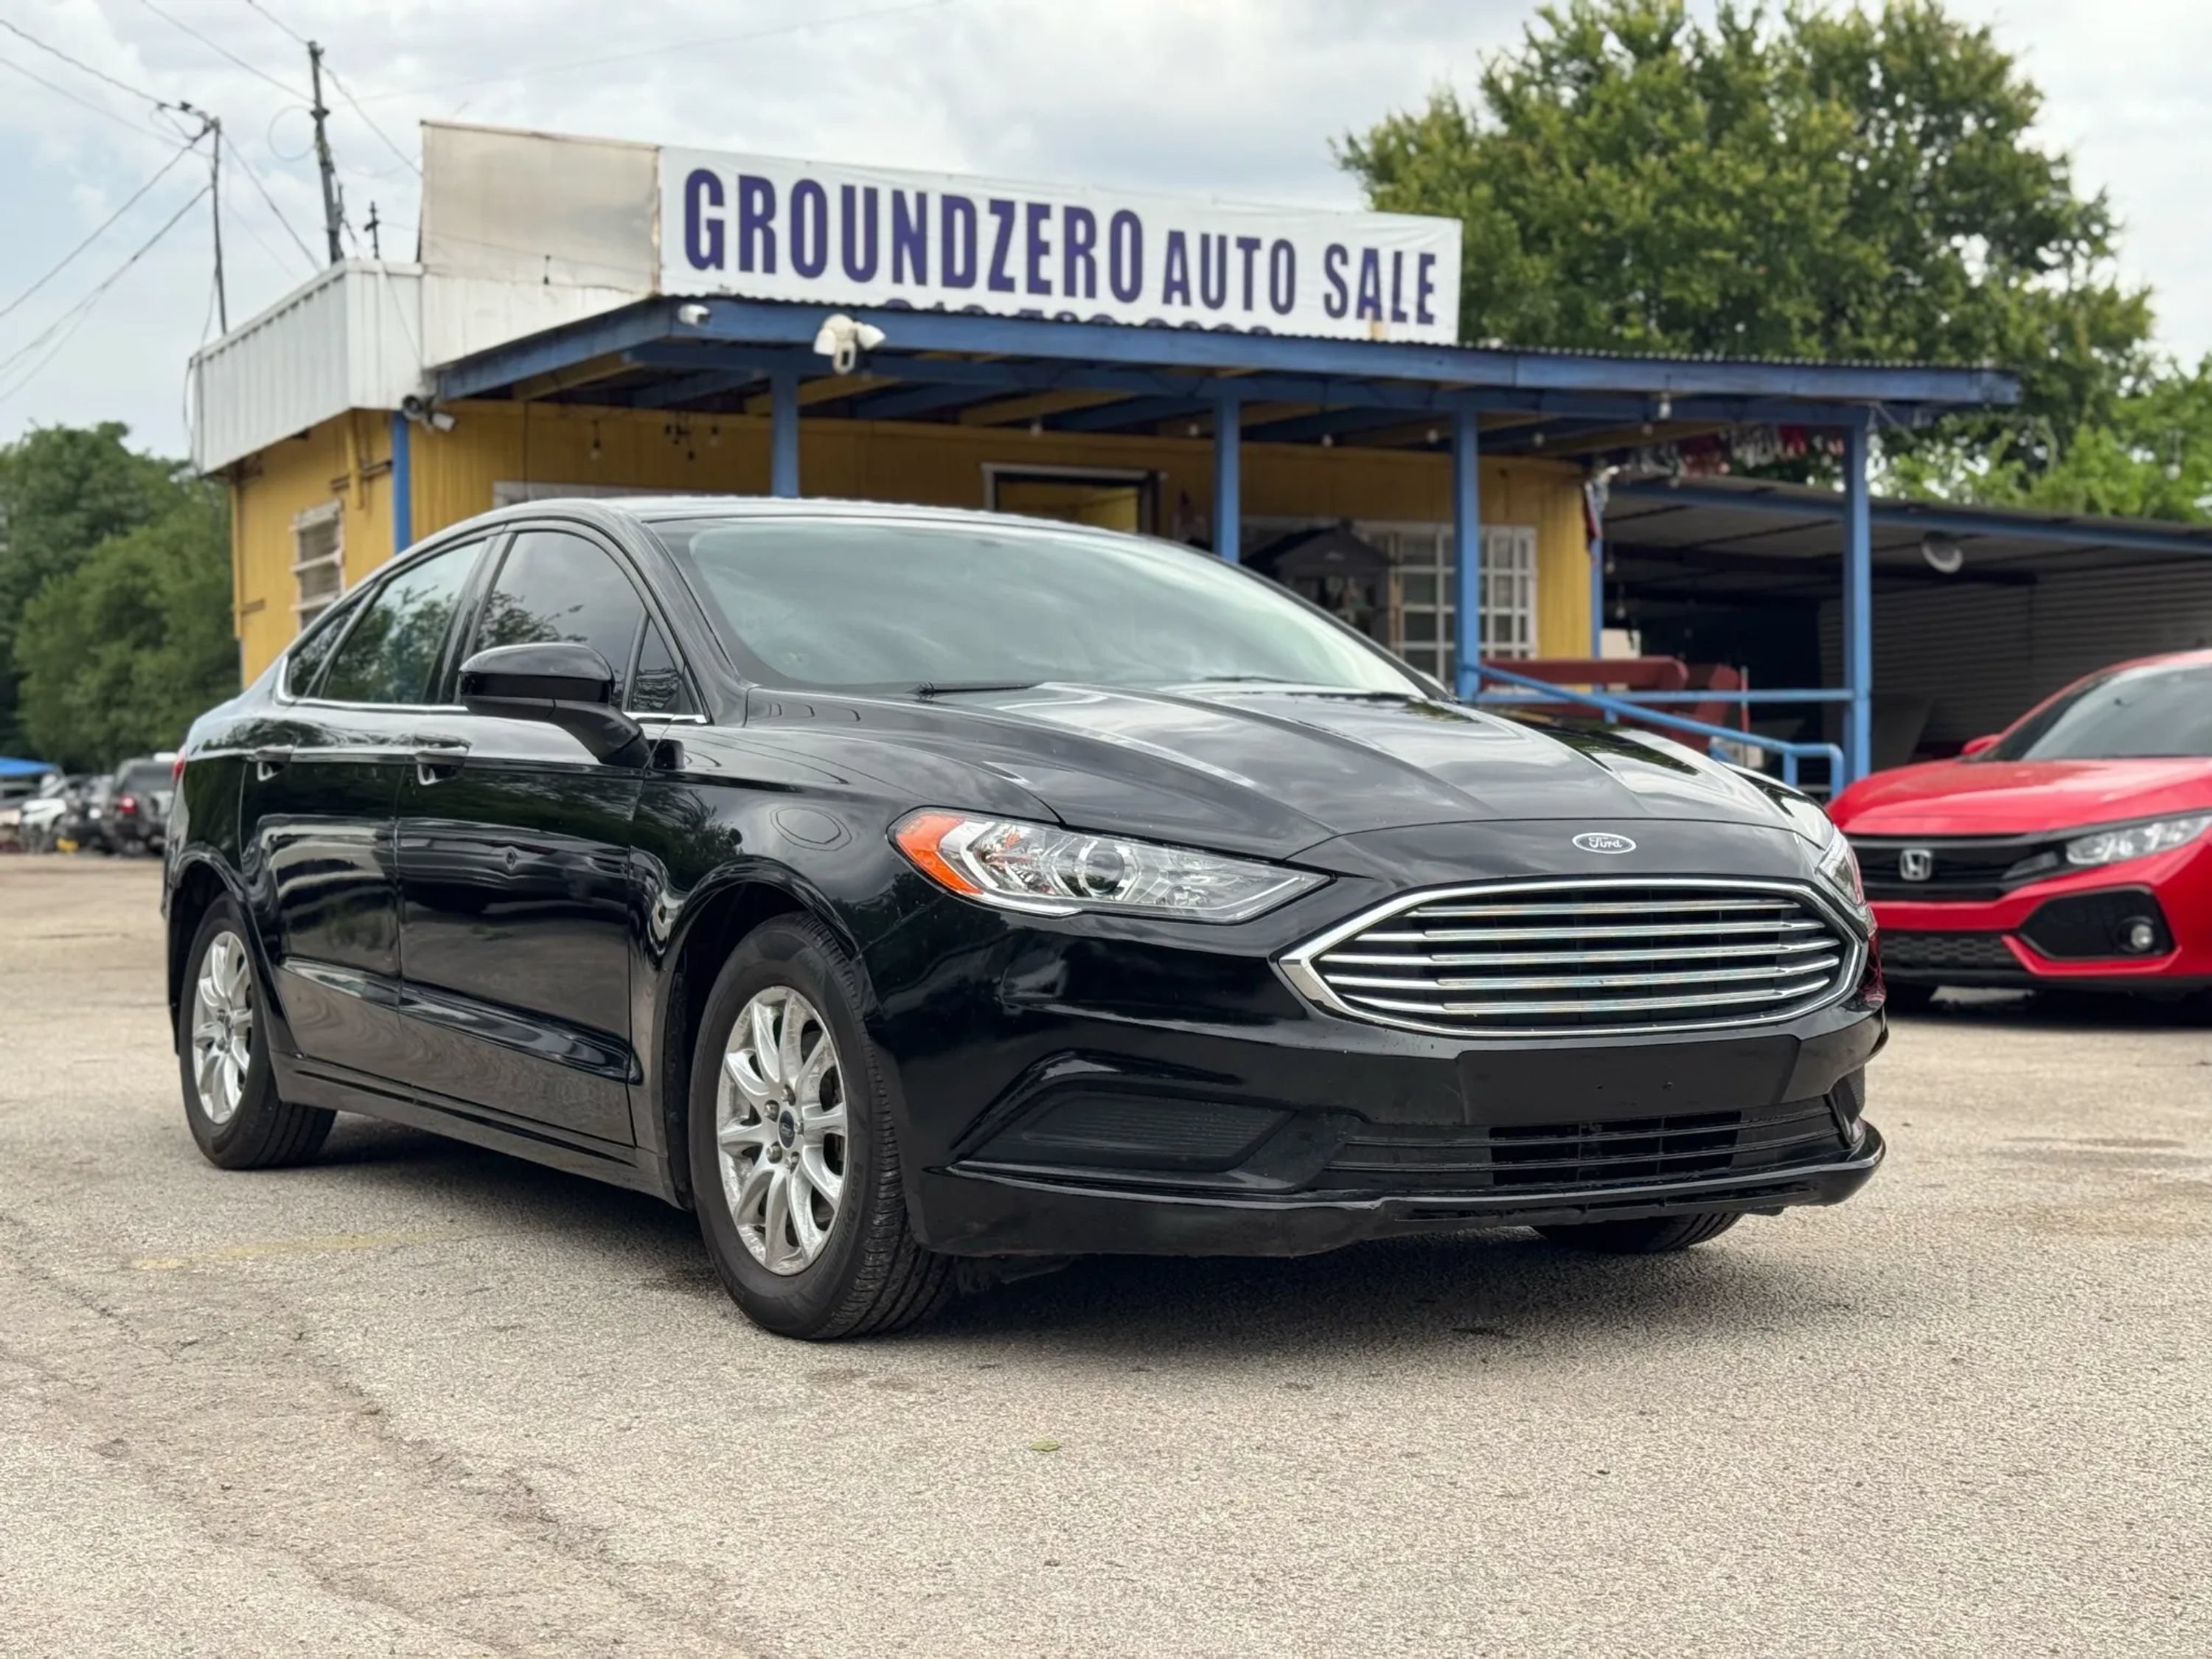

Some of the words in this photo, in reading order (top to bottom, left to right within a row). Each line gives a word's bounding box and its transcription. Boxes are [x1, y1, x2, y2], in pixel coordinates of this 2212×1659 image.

[684, 168, 1144, 304] GROUNDZERO
[1162, 229, 1295, 315] AUTO
[1324, 243, 1436, 325] SALE
